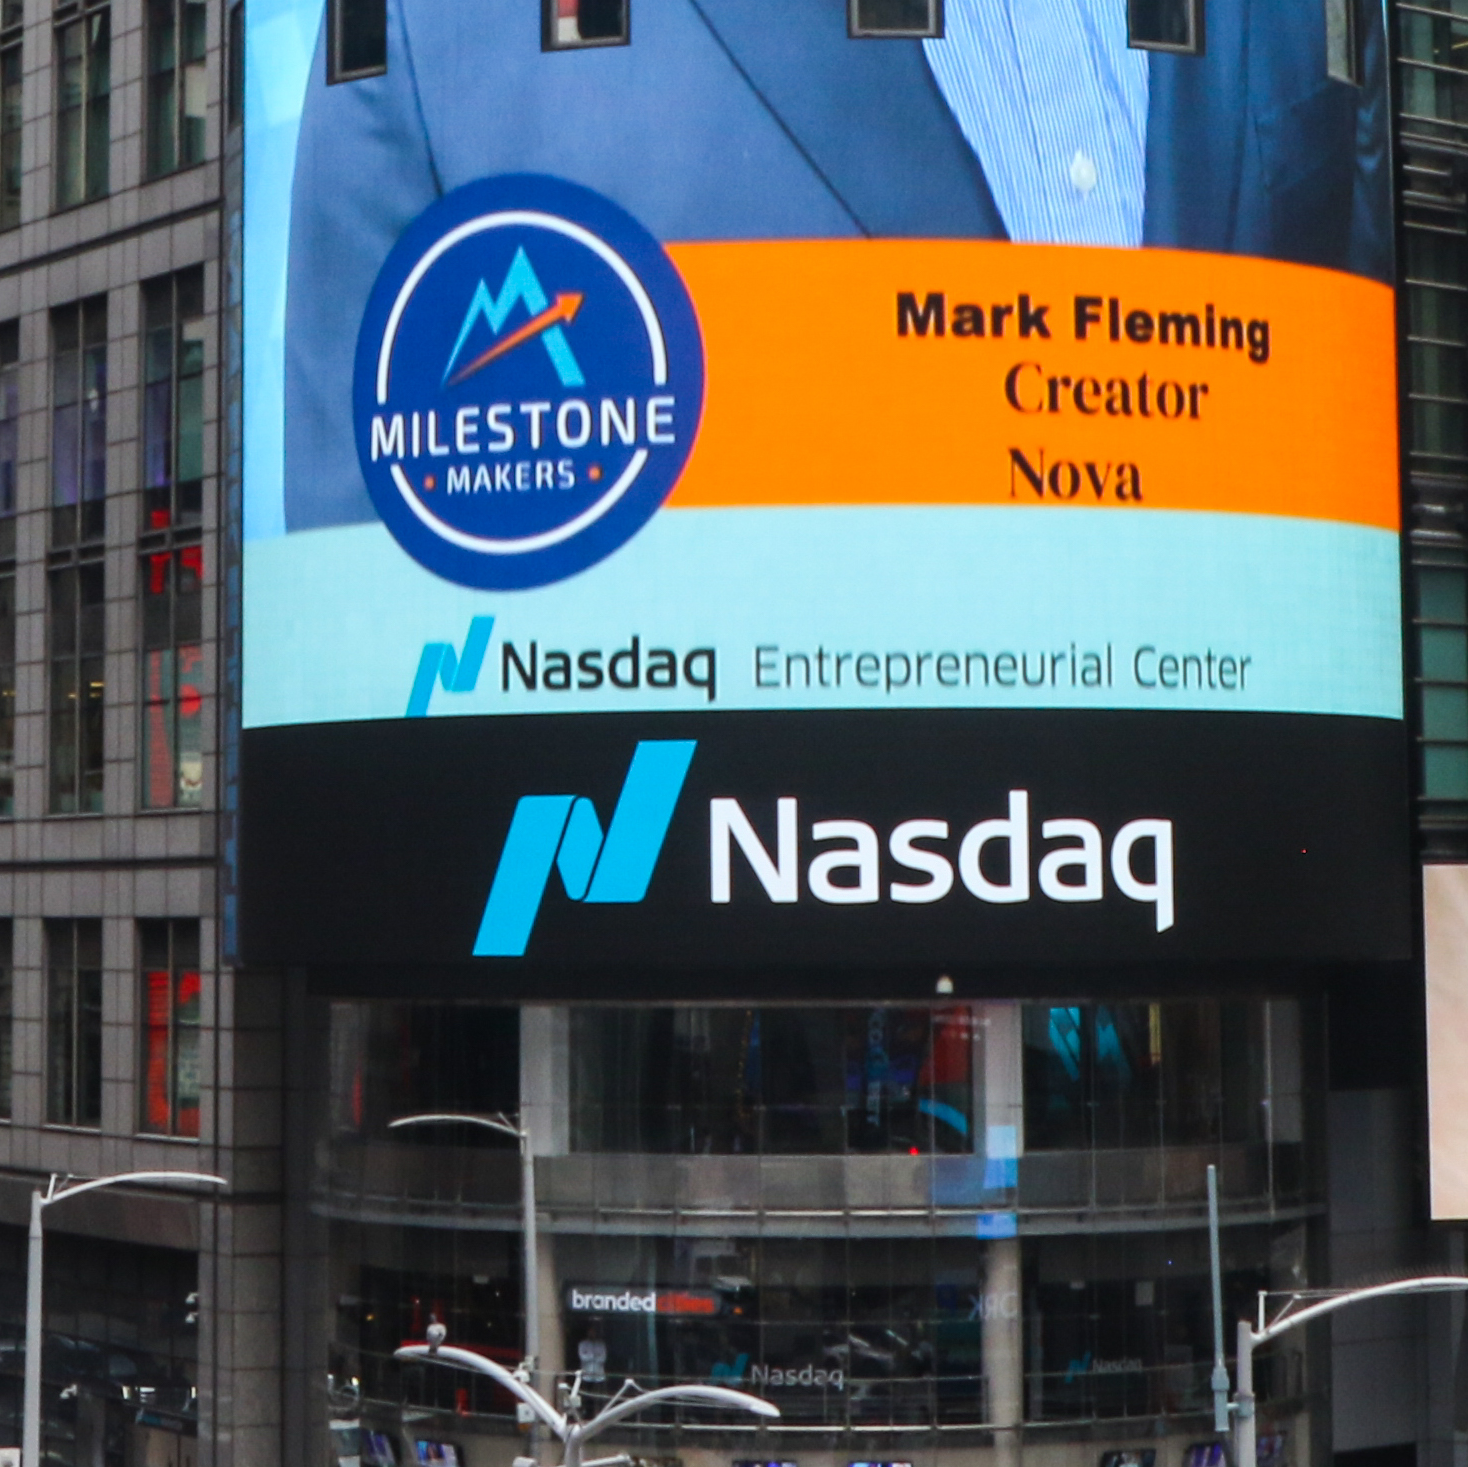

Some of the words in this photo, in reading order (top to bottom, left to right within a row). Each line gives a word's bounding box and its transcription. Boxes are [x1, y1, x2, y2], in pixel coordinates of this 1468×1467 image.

[895, 290, 1052, 340] Mark
[1073, 294, 1272, 364] Fleming
[1004, 360, 1210, 421] Creator
[370, 395, 676, 462] MILESTONE
[447, 458, 576, 495] MAKERS
[1007, 446, 1144, 504] Nova
[500, 637, 717, 703] Nasdaq
[754, 643, 1114, 695] Entrepreneurial
[1134, 645, 1252, 694] Center
[709, 788, 1175, 932] Nasdaq
[750, 1363, 844, 1391] Nasdaq
